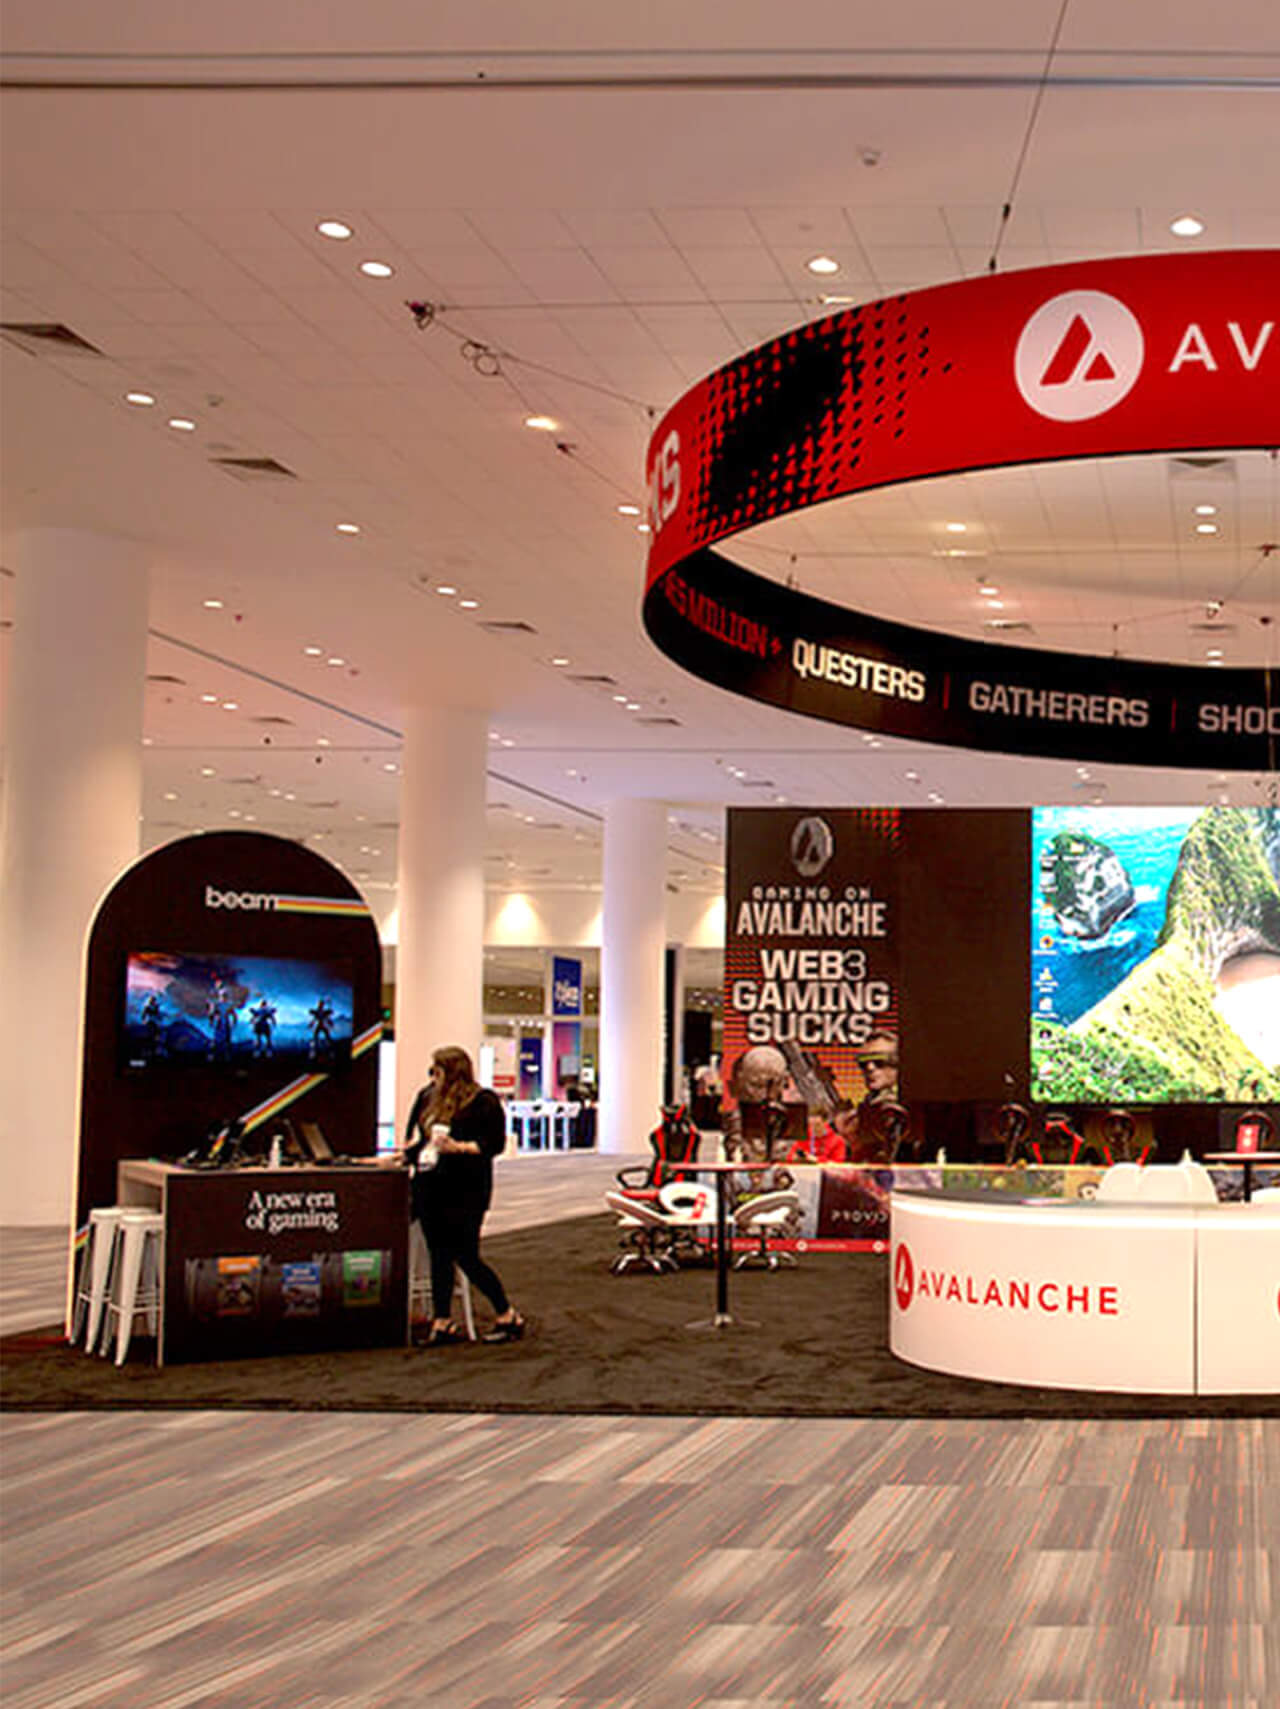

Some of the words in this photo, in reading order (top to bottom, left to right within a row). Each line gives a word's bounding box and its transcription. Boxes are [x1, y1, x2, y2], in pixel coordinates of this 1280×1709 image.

[792, 638, 926, 702] QUESTERS
[968, 682, 1150, 728] GATHERERS
[205, 885, 278, 910] beam
[736, 901, 888, 937] AVALANCHE
[760, 949, 867, 980] WEB3
[732, 980, 890, 1012] GAMING
[748, 1011, 874, 1044] SUCKS
[248, 1190, 263, 1209] A
[266, 1191, 302, 1208] new
[306, 1191, 336, 1208] era
[245, 1208, 267, 1230] of
[268, 1210, 340, 1235] gaming
[918, 1268, 1119, 1316] AVALANCHE
